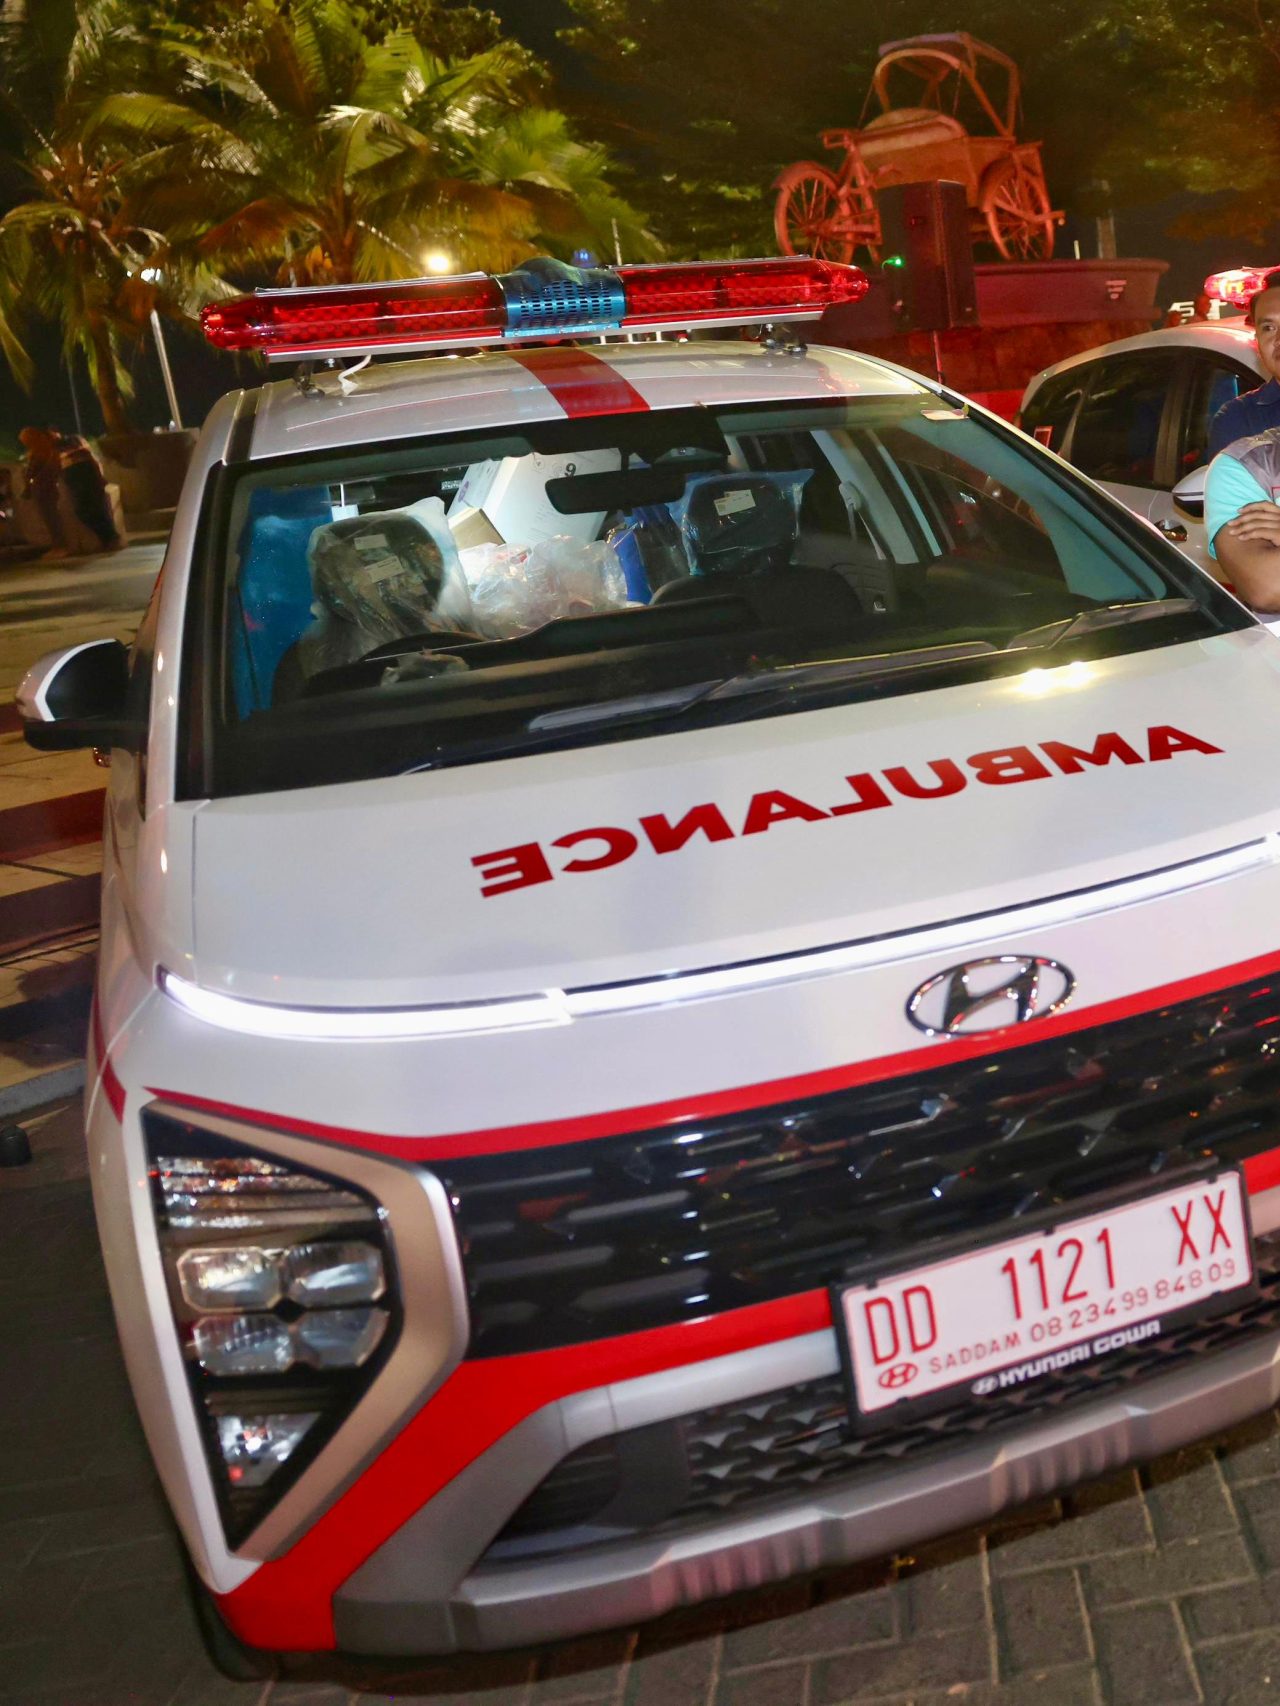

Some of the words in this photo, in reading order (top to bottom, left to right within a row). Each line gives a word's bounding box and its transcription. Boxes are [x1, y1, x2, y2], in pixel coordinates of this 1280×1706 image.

[863, 1285, 938, 1366] DD
[1001, 1227, 1116, 1320] 1121
[1170, 1189, 1232, 1267] XX
[929, 1331, 1022, 1375] SADDAM
[999, 1344, 1091, 1388] HYUNDAI
[1093, 1319, 1161, 1357] GOWA
